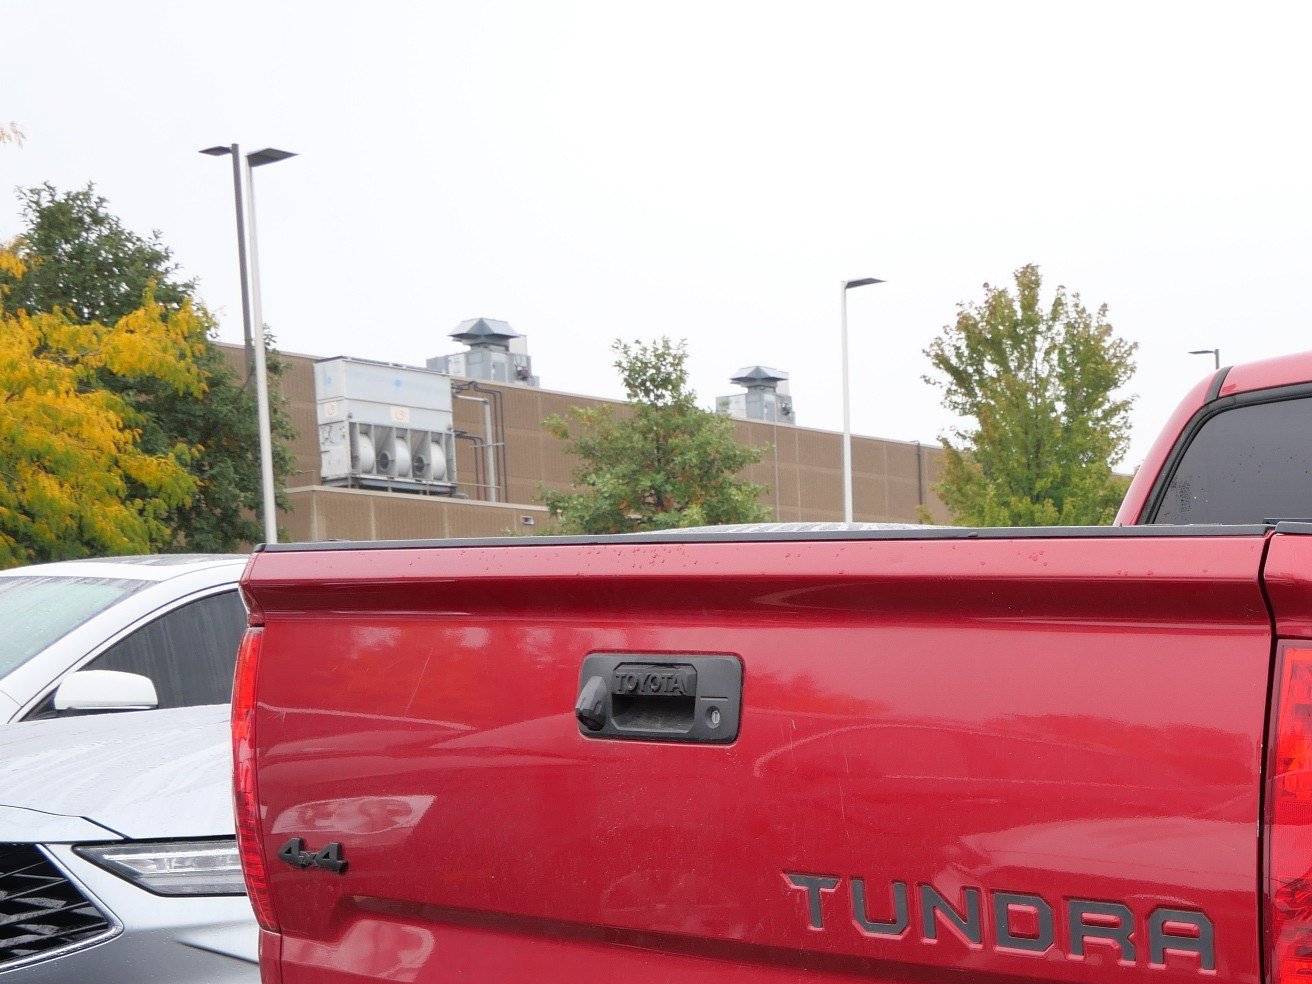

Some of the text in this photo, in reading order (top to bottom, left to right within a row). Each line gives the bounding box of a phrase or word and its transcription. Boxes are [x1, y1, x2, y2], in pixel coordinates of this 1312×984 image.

[615, 672, 686, 696] TOYOTA
[278, 837, 347, 874] 4x4
[782, 870, 1219, 976] TUNDRA
